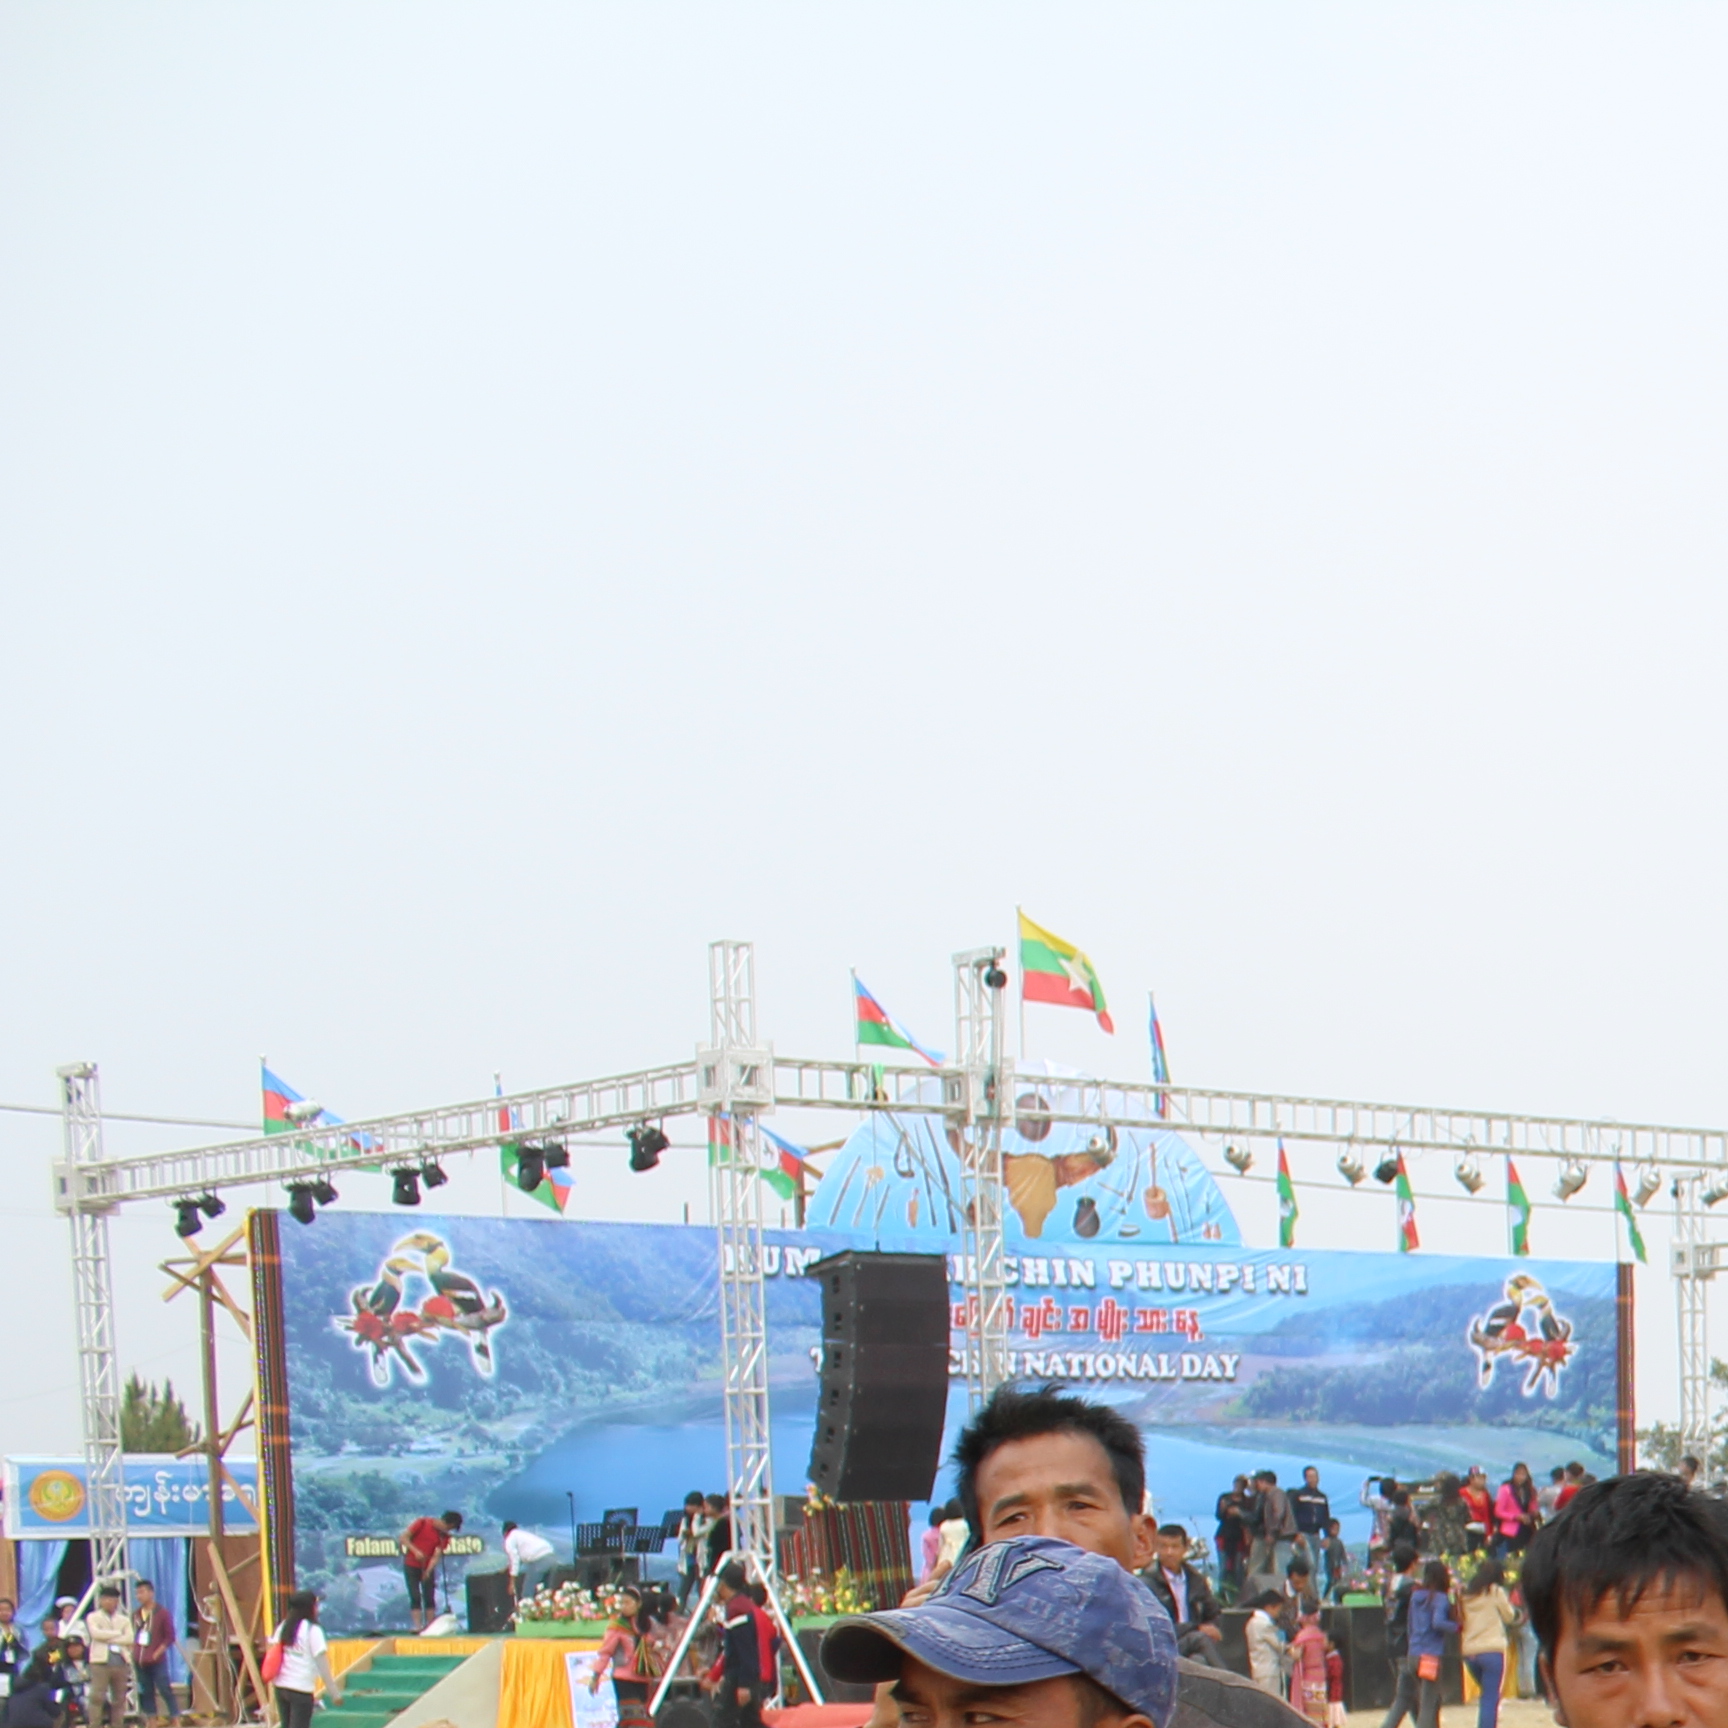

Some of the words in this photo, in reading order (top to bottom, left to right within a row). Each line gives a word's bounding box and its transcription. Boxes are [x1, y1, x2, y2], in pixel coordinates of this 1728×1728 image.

[996, 1256, 1096, 1288] CHIN
[1108, 1259, 1256, 1292] PHUNPI
[1266, 1263, 1308, 1294] NI
[1023, 1351, 1177, 1380] NATIONAL
[1180, 1353, 1240, 1381] DAY
[346, 1536, 400, 1557] Falam,
